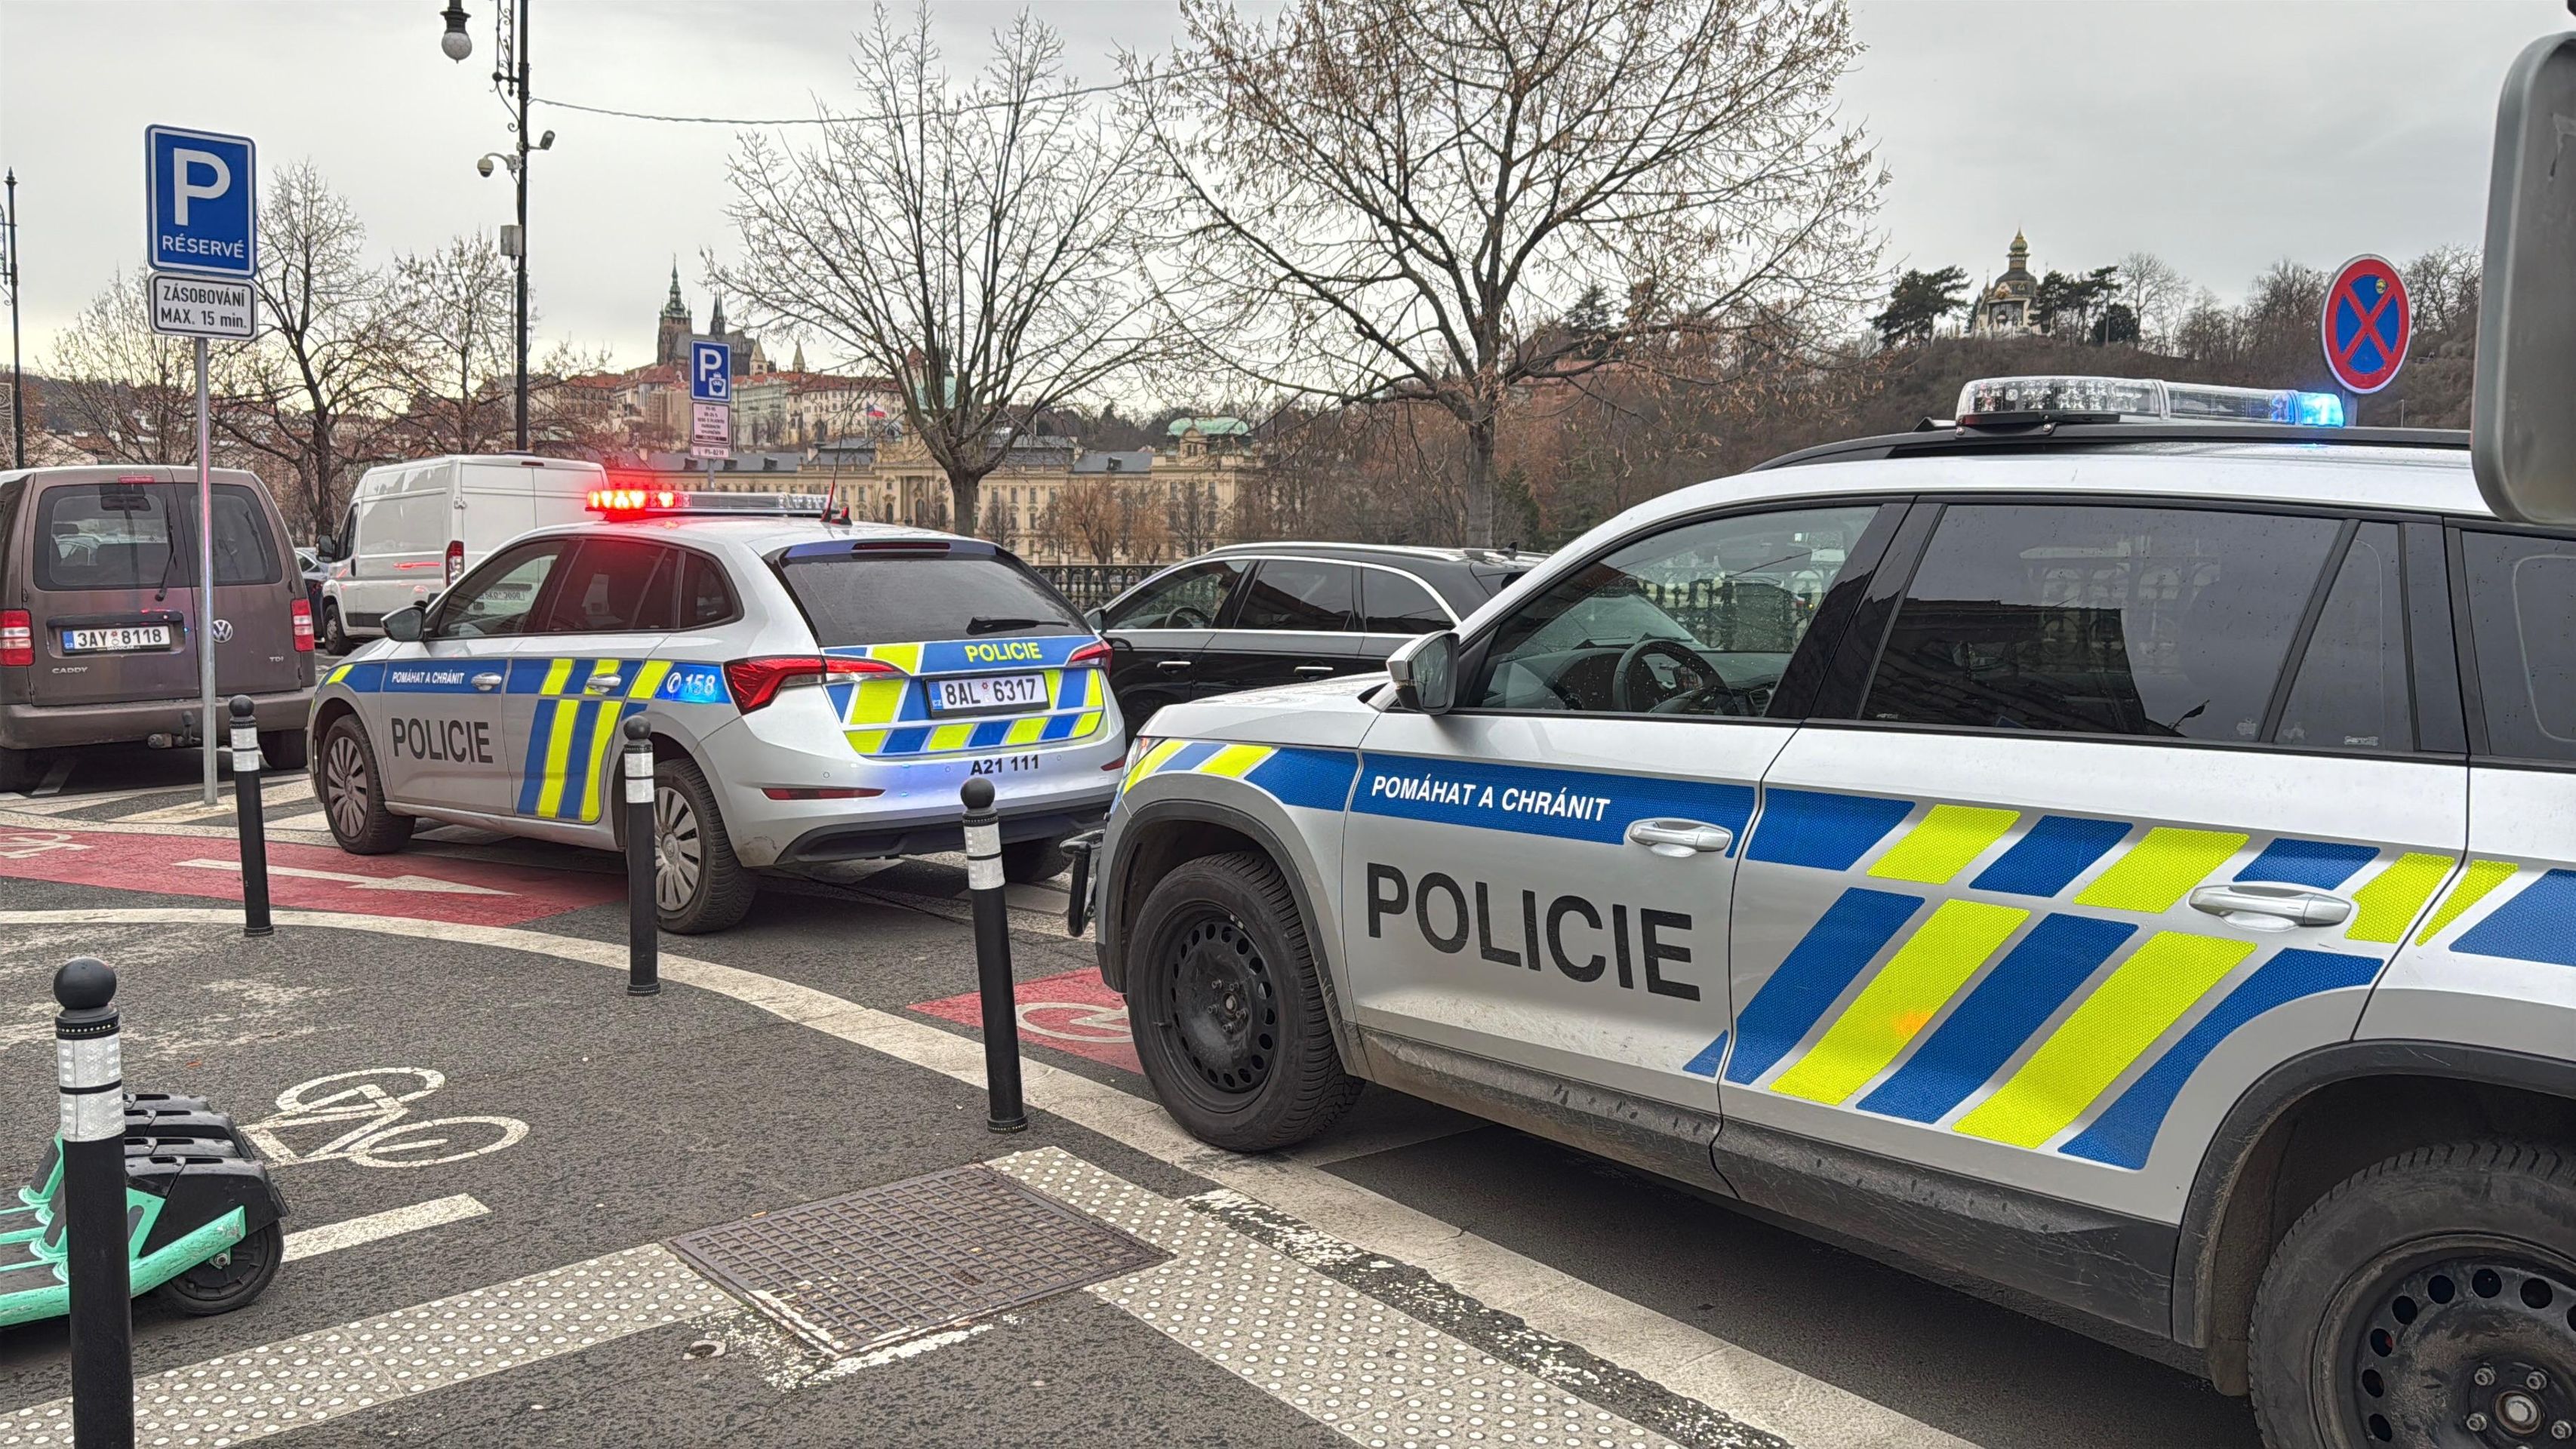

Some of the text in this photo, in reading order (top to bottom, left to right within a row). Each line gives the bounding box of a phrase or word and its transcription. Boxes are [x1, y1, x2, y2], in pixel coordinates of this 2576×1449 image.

[174, 147, 231, 226] P
[162, 232, 245, 259] RÉSERVÉ
[163, 283, 245, 307] ZÁSOBOVÁNÍ
[161, 307, 248, 329] MAX. 15 min.
[700, 348, 722, 382] P
[78, 629, 162, 647] 3AY 8118
[965, 642, 1043, 663] POLICIE
[392, 669, 465, 685] POMÁHAT A CHRÁNIT
[685, 673, 716, 696] 158
[945, 678, 1036, 706] 8AL 6317
[391, 718, 494, 764] POLICIE
[970, 754, 1039, 775] A21 111
[1371, 774, 1610, 821] POMÁHAT A CHRÁNIT
[1367, 862, 1701, 1002] POLICIE
